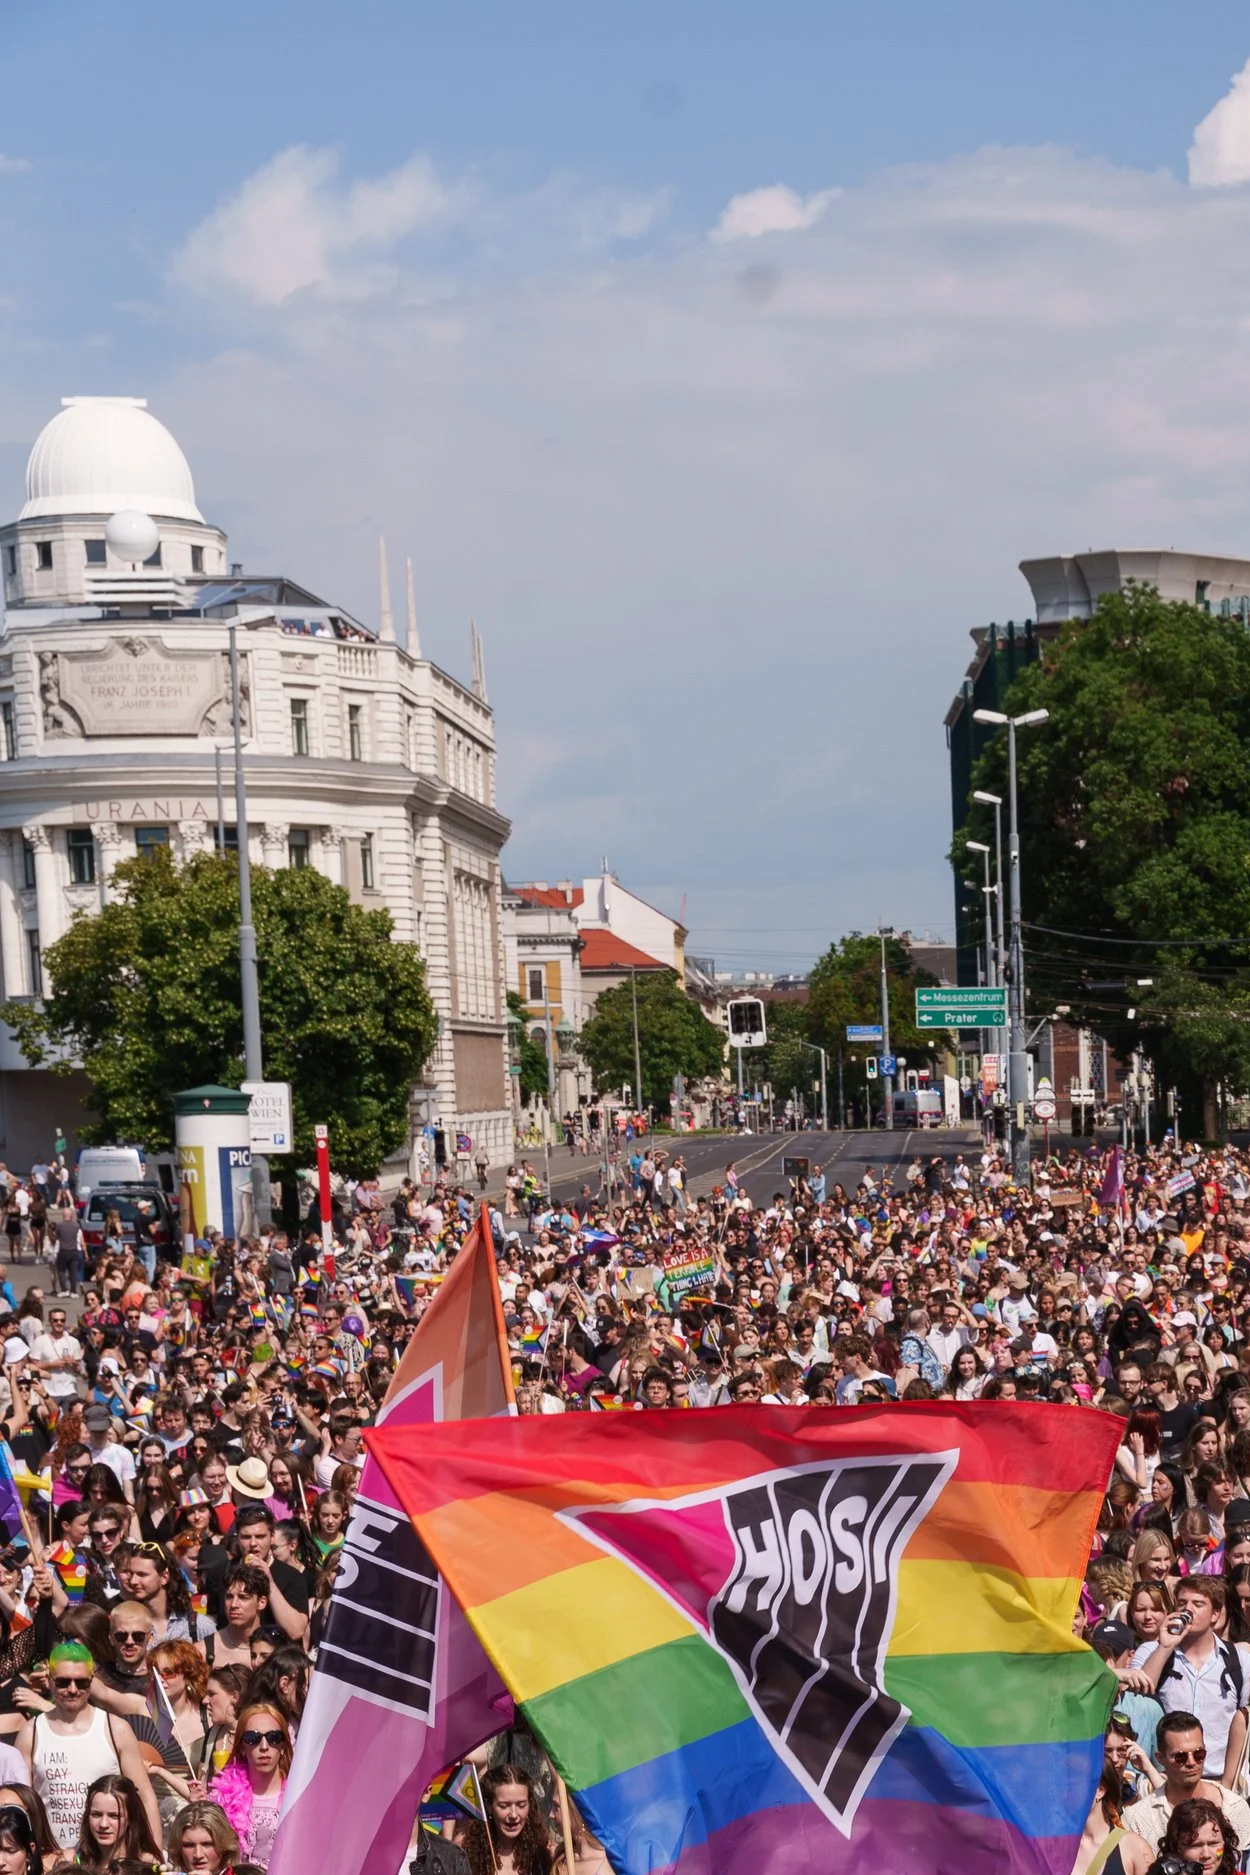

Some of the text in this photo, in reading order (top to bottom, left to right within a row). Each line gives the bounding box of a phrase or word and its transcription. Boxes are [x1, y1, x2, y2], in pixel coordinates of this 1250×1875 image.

[91, 686, 126, 697] FRANZ
[132, 686, 182, 698] JOSEPH
[85, 801, 208, 819] URANIA
[933, 993, 1003, 1002] Messezentrum
[944, 1013, 977, 1023] Prater
[251, 1109, 282, 1119] WIEN
[229, 1151, 250, 1166] PIC
[663, 1247, 708, 1268] LOVE IS A
[672, 1279, 692, 1292] THING
[725, 1495, 919, 1614] HOSI
[49, 1752, 68, 1764] AM:
[45, 1768, 69, 1780] GAY
[49, 1798, 84, 1810] BISEXU
